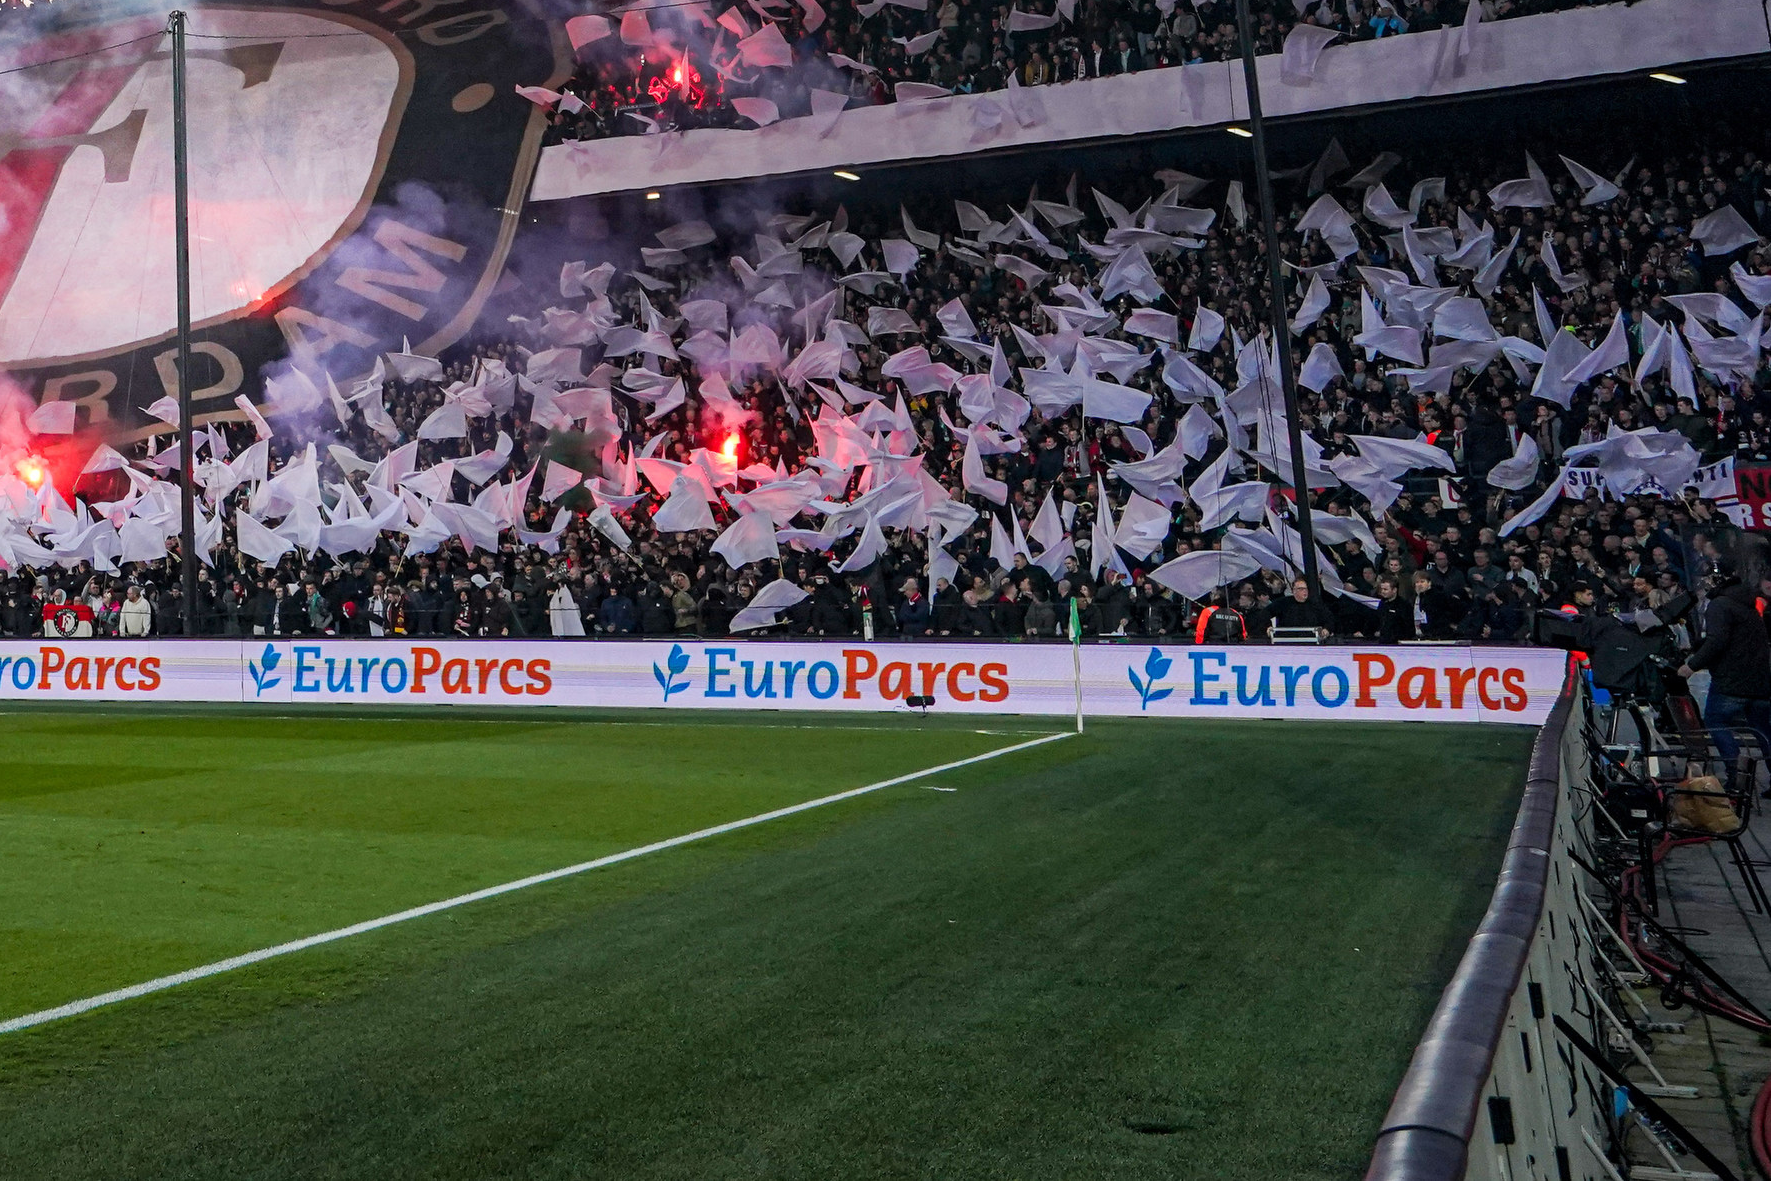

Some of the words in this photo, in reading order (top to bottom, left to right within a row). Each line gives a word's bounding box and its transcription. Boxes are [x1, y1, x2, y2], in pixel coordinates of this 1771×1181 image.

[292, 646, 552, 696] EuroParcs
[704, 647, 1009, 703] EuroParcs
[1188, 651, 1528, 712] EuroParcs
